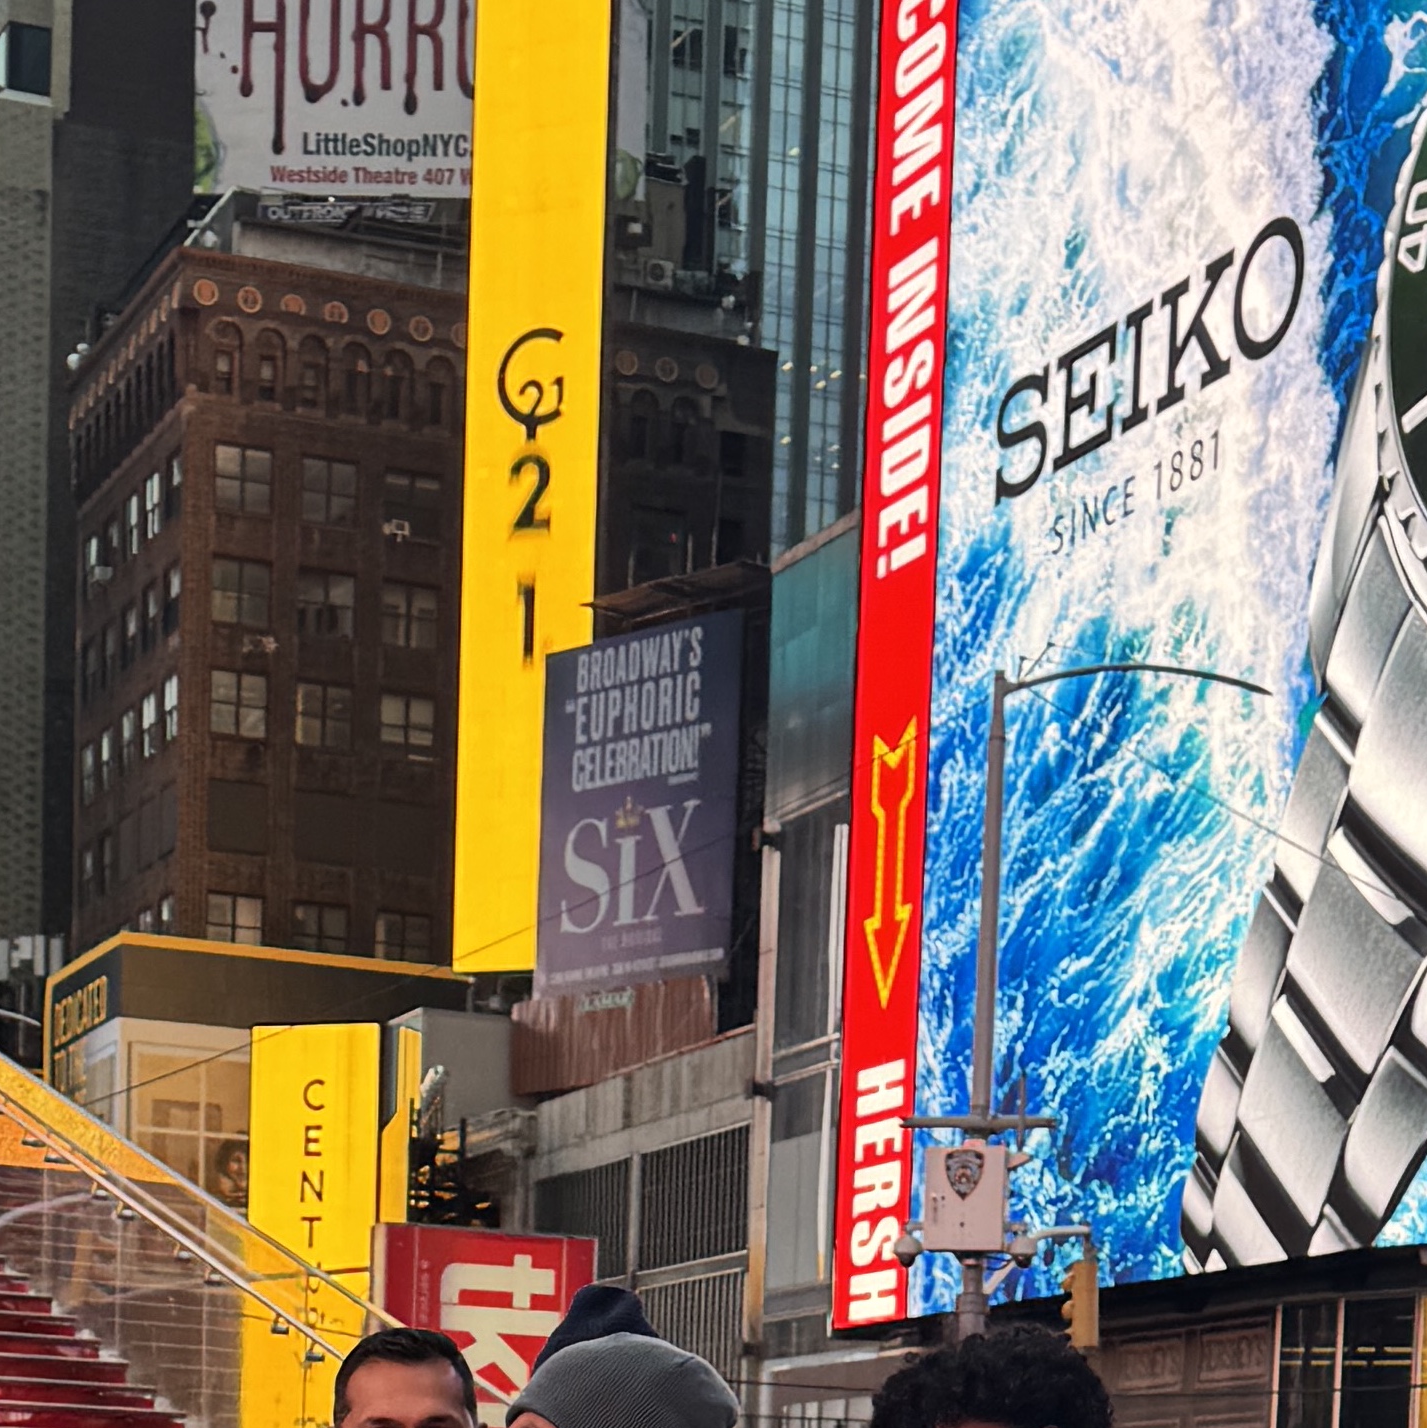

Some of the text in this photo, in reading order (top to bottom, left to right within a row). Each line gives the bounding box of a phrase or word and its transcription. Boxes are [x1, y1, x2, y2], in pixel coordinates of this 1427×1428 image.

[271, 165, 348, 186] Westside
[353, 166, 417, 187] Theatre
[422, 168, 455, 187] 407
[876, 236, 939, 580] INSIDE!
[994, 216, 1305, 507] SEIKO
[1051, 429, 1220, 555] SINCE 1881
[576, 626, 704, 694] BROADWAY'S
[560, 799, 707, 934] SIX
[846, 1058, 907, 1322] HERSH
